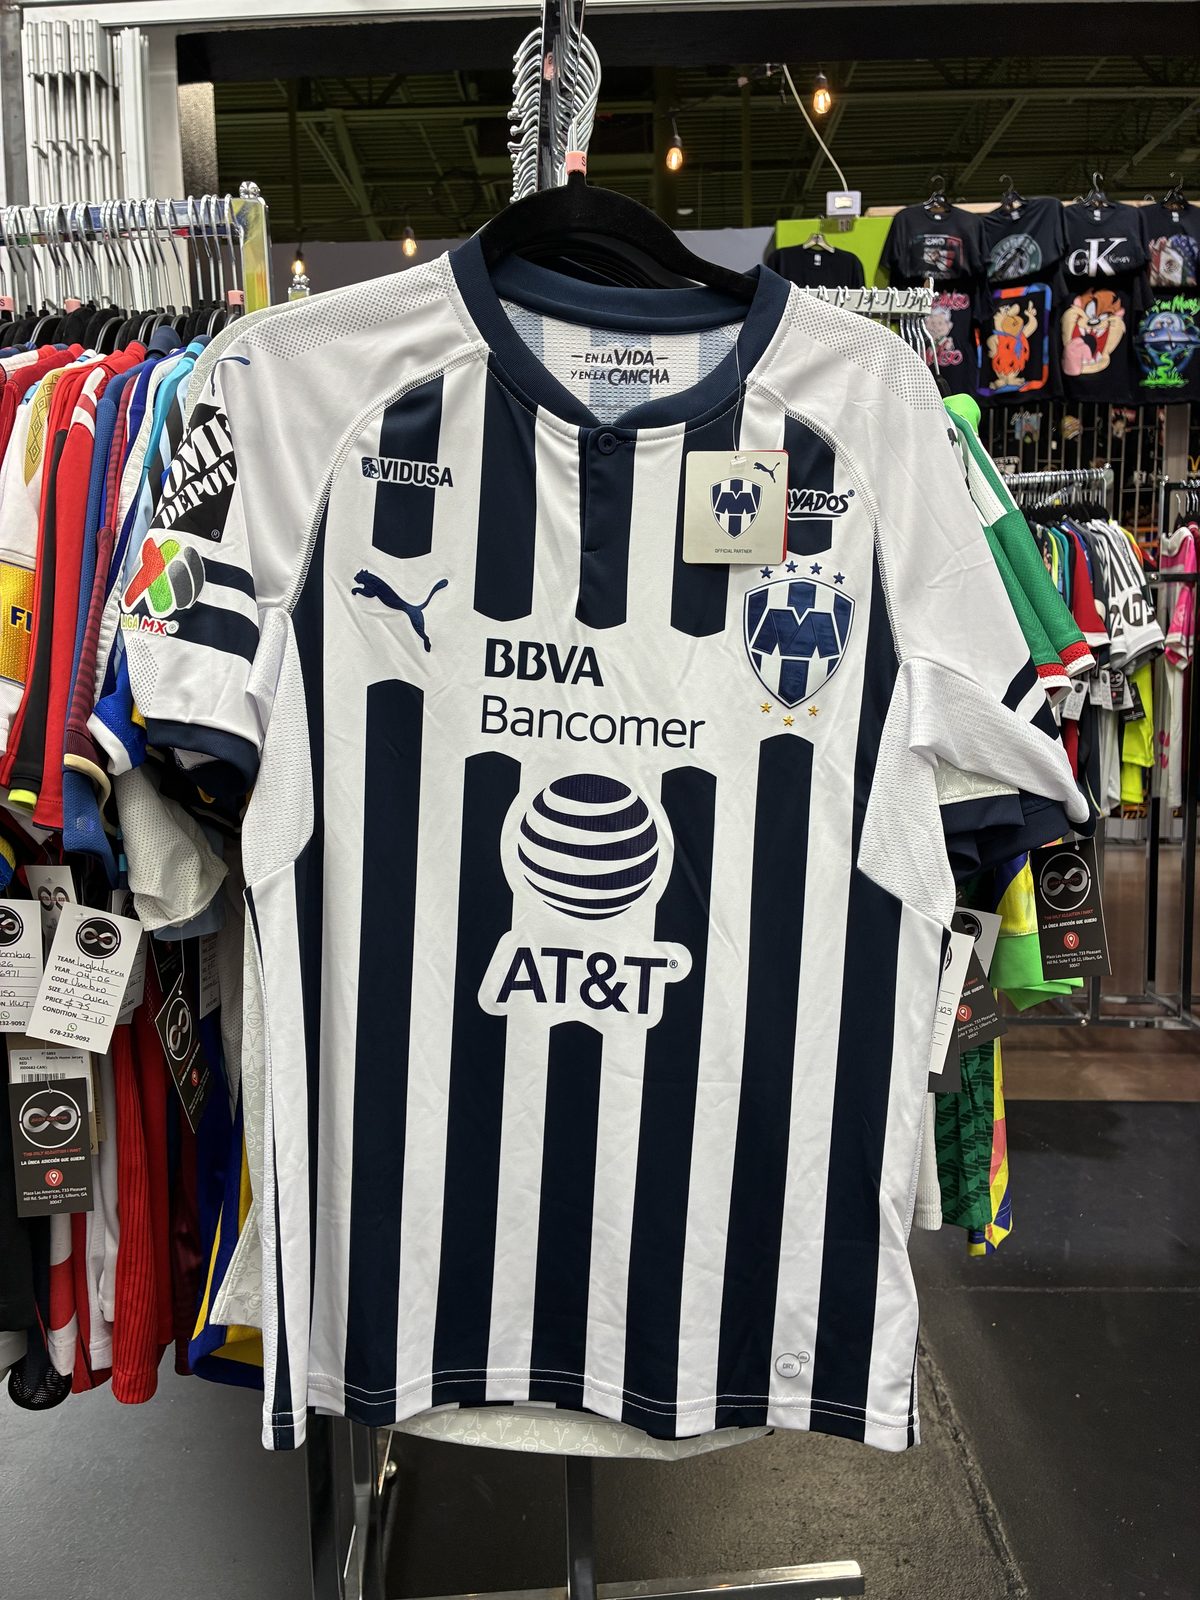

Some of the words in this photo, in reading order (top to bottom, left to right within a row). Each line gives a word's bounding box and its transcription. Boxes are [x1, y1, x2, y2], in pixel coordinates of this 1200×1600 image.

[585, 353, 599, 364] EN
[601, 354, 612, 364] LA
[614, 349, 655, 366] VIDA
[570, 369, 577, 380] Y
[578, 370, 592, 380] EN
[593, 370, 606, 380] LA
[607, 367, 670, 386] CANCHA
[380, 459, 454, 488] VIDUSA
[160, 459, 236, 529] DEPOT
[141, 618, 167, 635] MX
[484, 638, 604, 688] BBVA
[480, 694, 707, 749] Bancomer
[57, 955, 75, 965] TEAM
[54, 965, 70, 974] YEAR
[51, 975, 68, 984] CODE
[495, 946, 668, 1015] AT&T
[48, 985, 61, 993] SIZE
[45, 995, 62, 1004] PRICE
[42, 1005, 77, 1018] CONDITION
[49, 1028, 90, 1042] 678-232-9092
